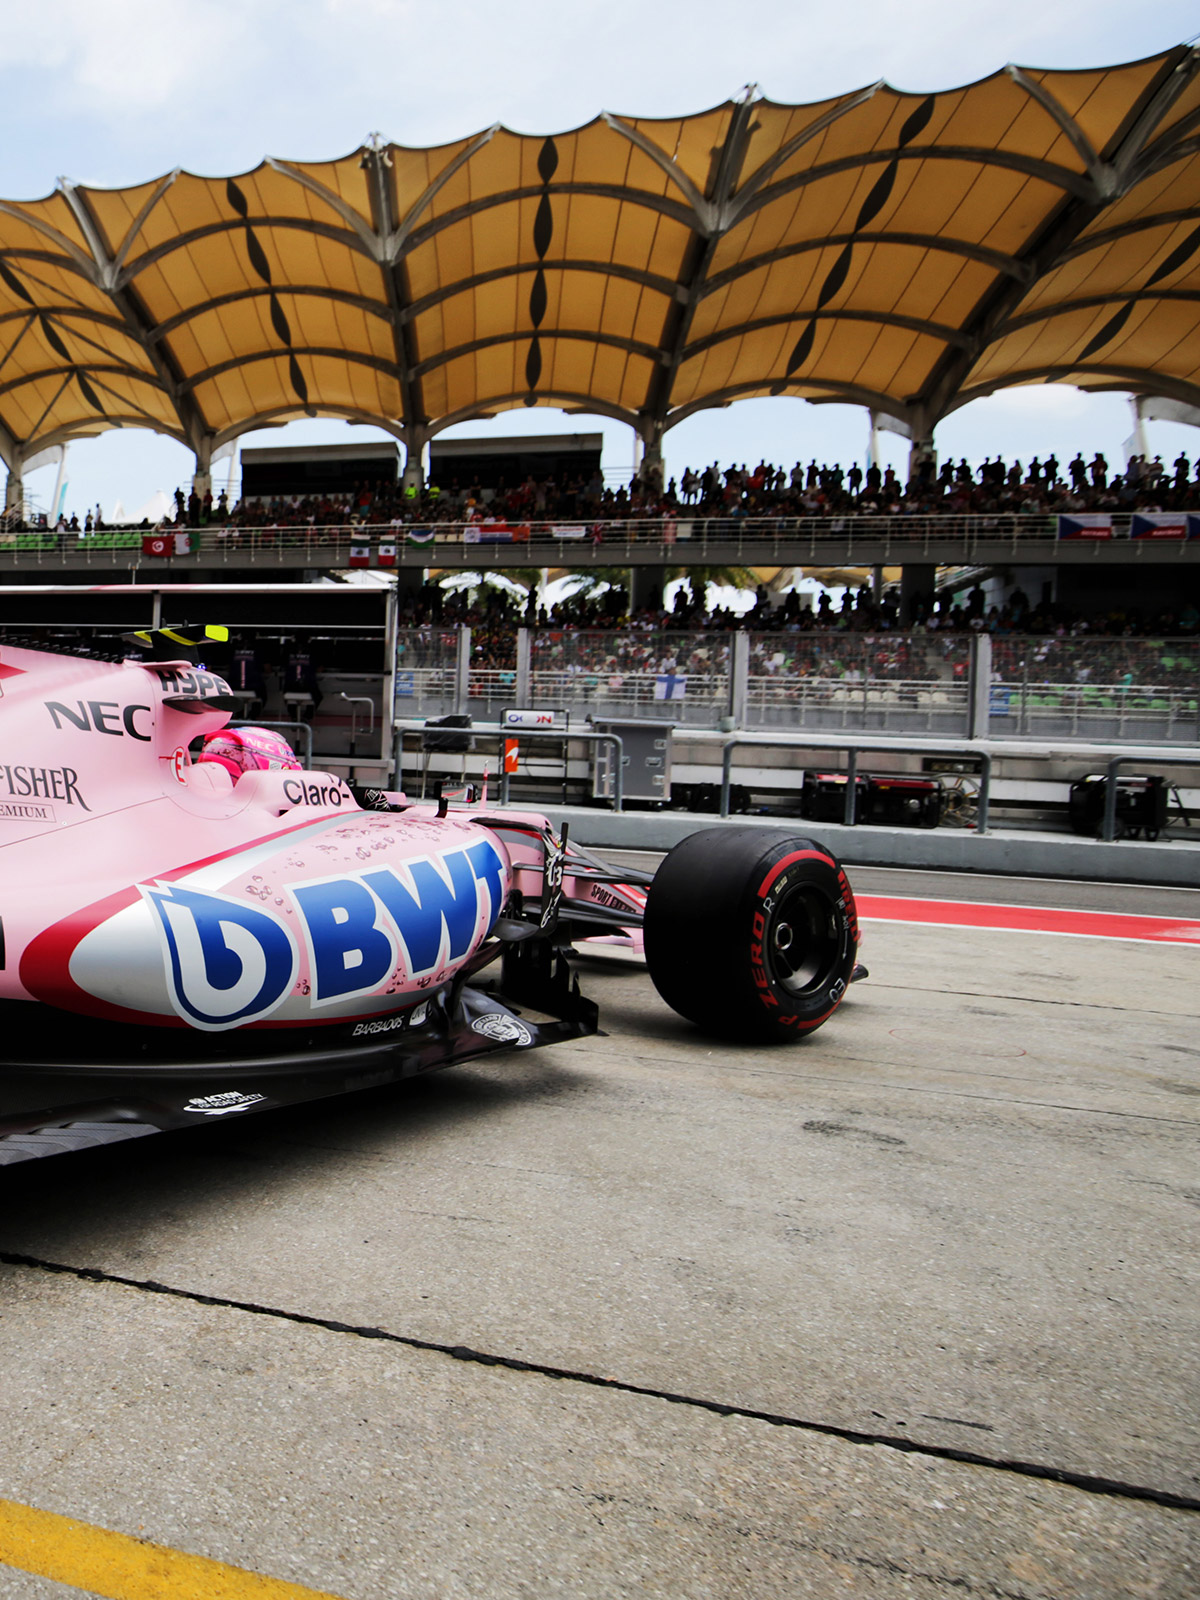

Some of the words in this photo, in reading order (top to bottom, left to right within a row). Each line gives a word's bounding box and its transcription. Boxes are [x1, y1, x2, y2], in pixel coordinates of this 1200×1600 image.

[155, 670, 231, 697] HYPE
[43, 700, 152, 742] NEC
[245, 737, 276, 753] NEC
[283, 778, 342, 807] Claro
[591, 884, 612, 906] SPORT
[291, 840, 504, 1001] BWT
[751, 911, 780, 1009] ZERO
[352, 1016, 405, 1036] BARBADOS
